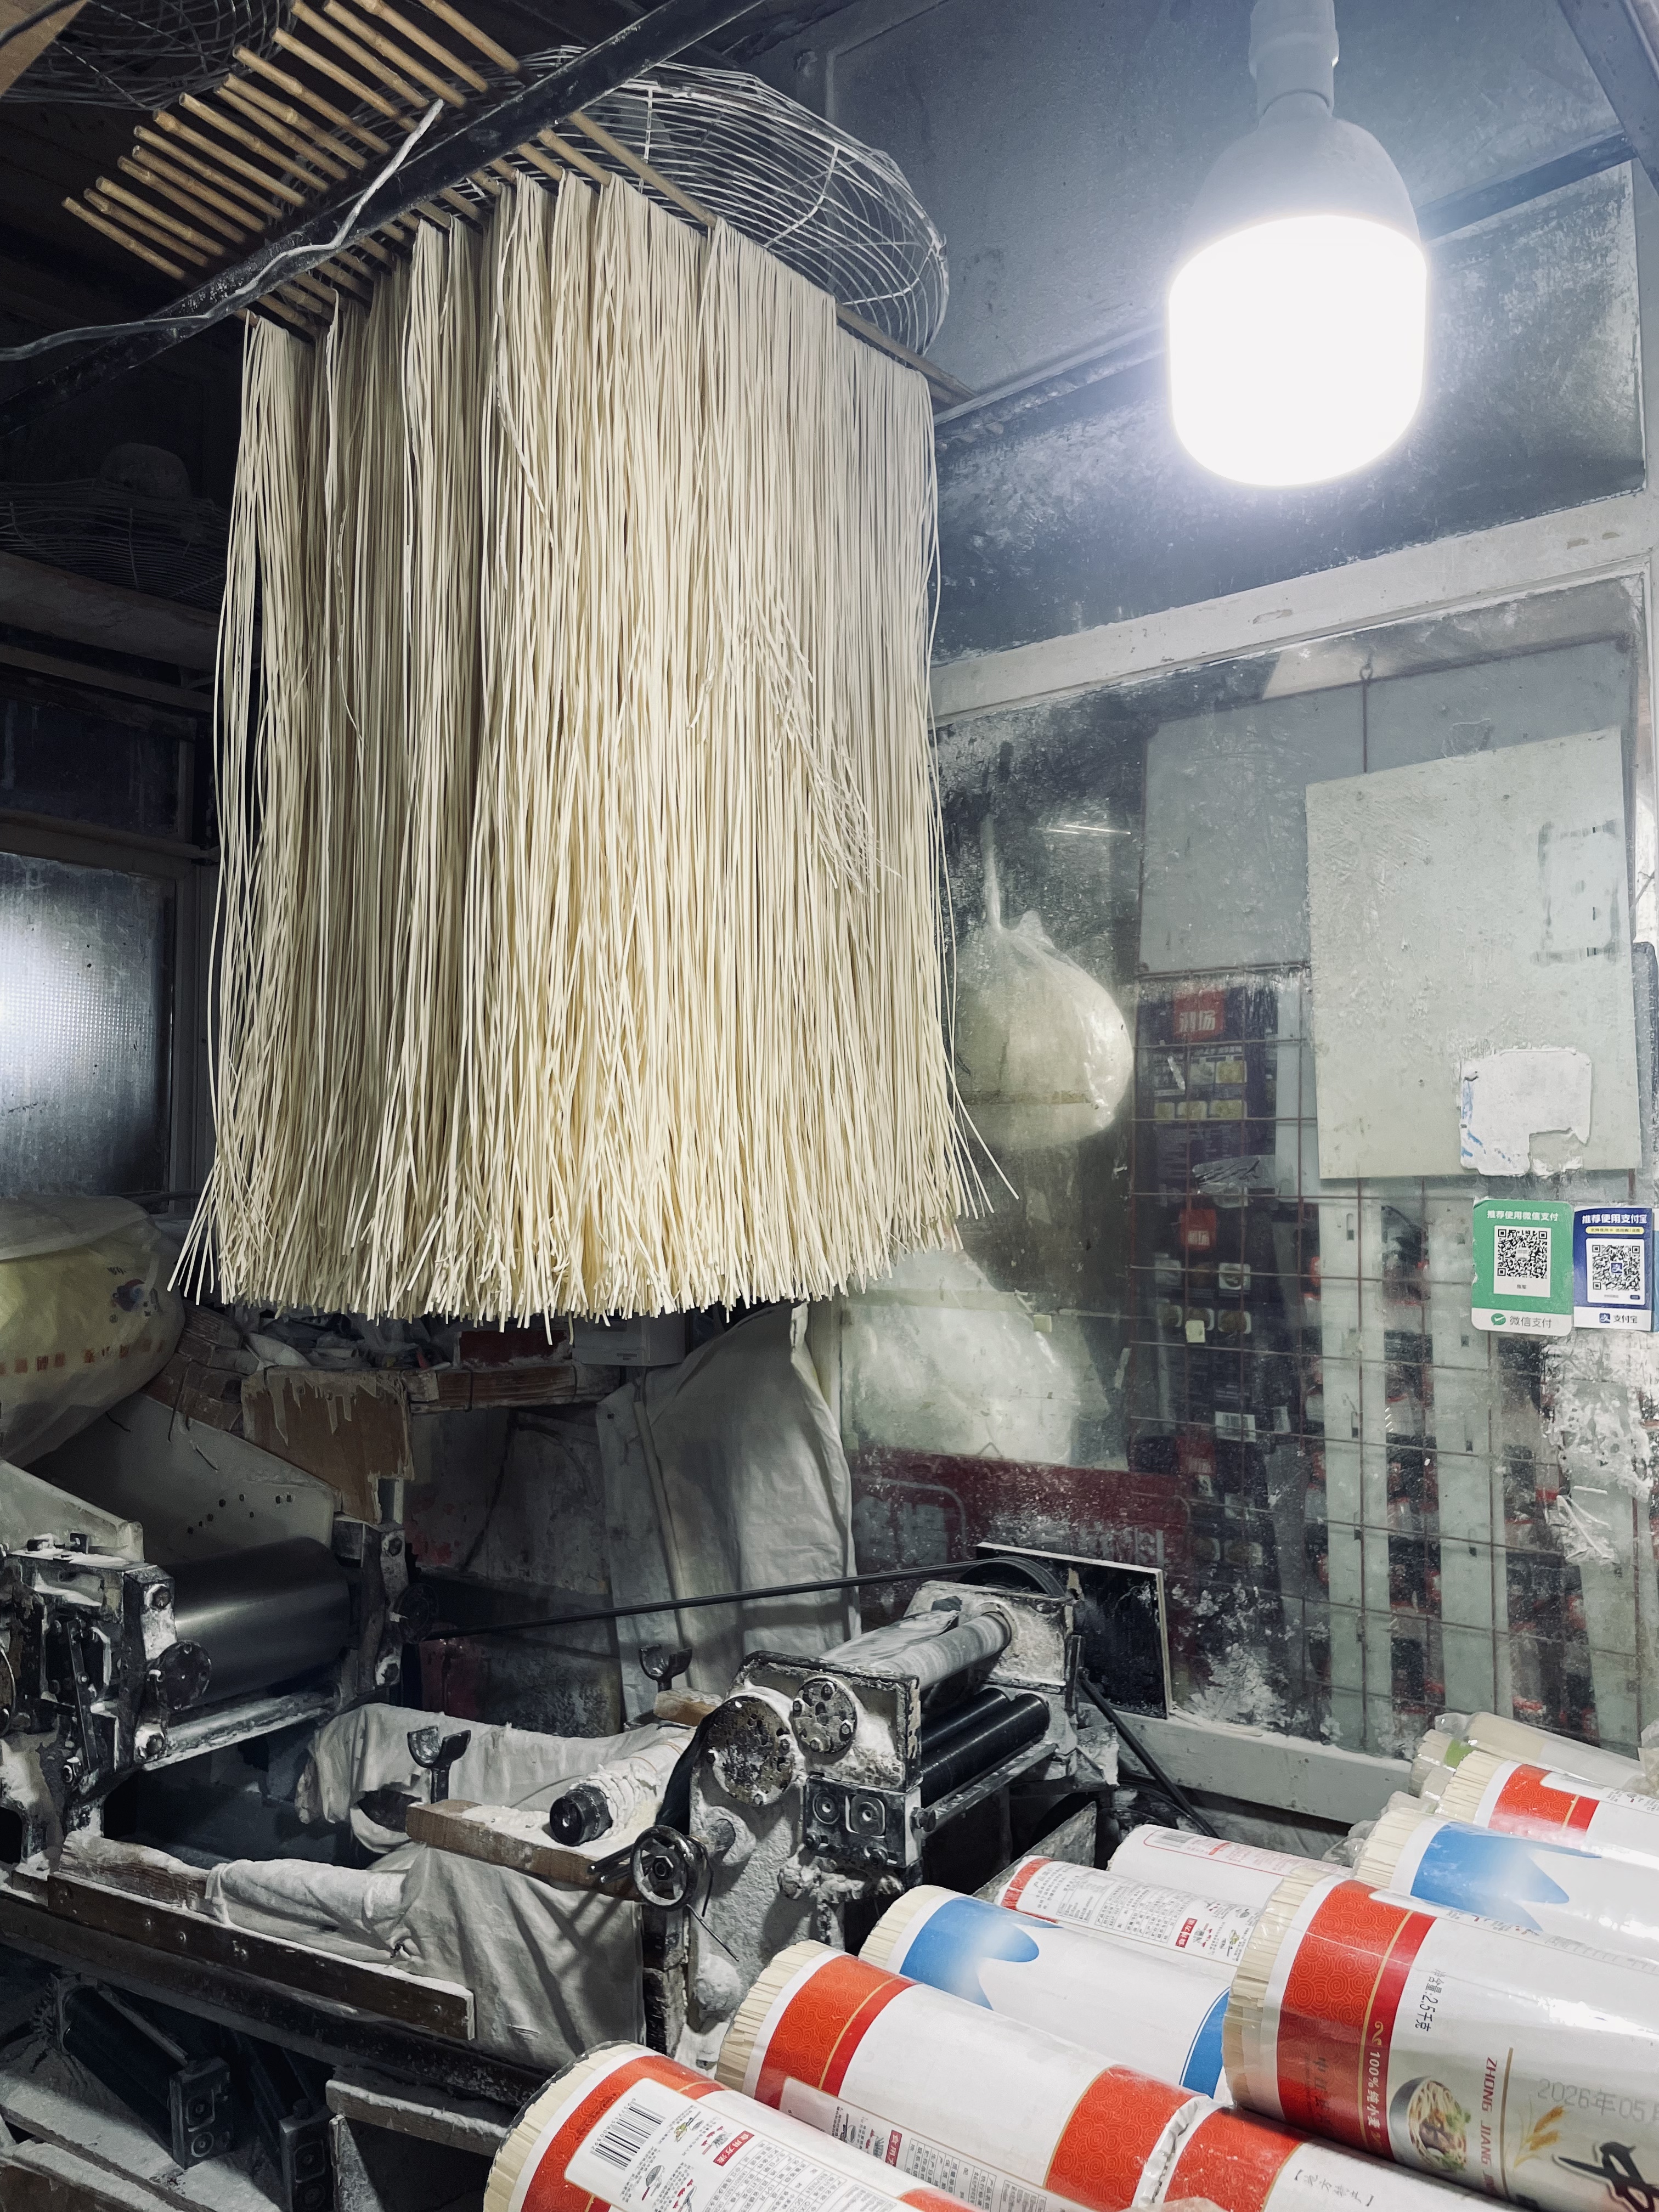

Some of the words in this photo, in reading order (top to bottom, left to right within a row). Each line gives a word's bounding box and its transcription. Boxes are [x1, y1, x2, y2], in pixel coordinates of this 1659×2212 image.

[1487, 1210, 1559, 1221] 推荐使用微信支付
[1582, 1214, 1647, 1224] 推荐使用支付宝
[1510, 1316, 1552, 1329] 微信支付
[1613, 1314, 1638, 1324] 支付宝
[1366, 2051, 1381, 2129] 100%纯小麦
[1481, 2057, 1498, 2112] ZHONG
[717, 2133, 750, 2163] 食用方法
[1481, 2120, 1492, 2165] JIANG
